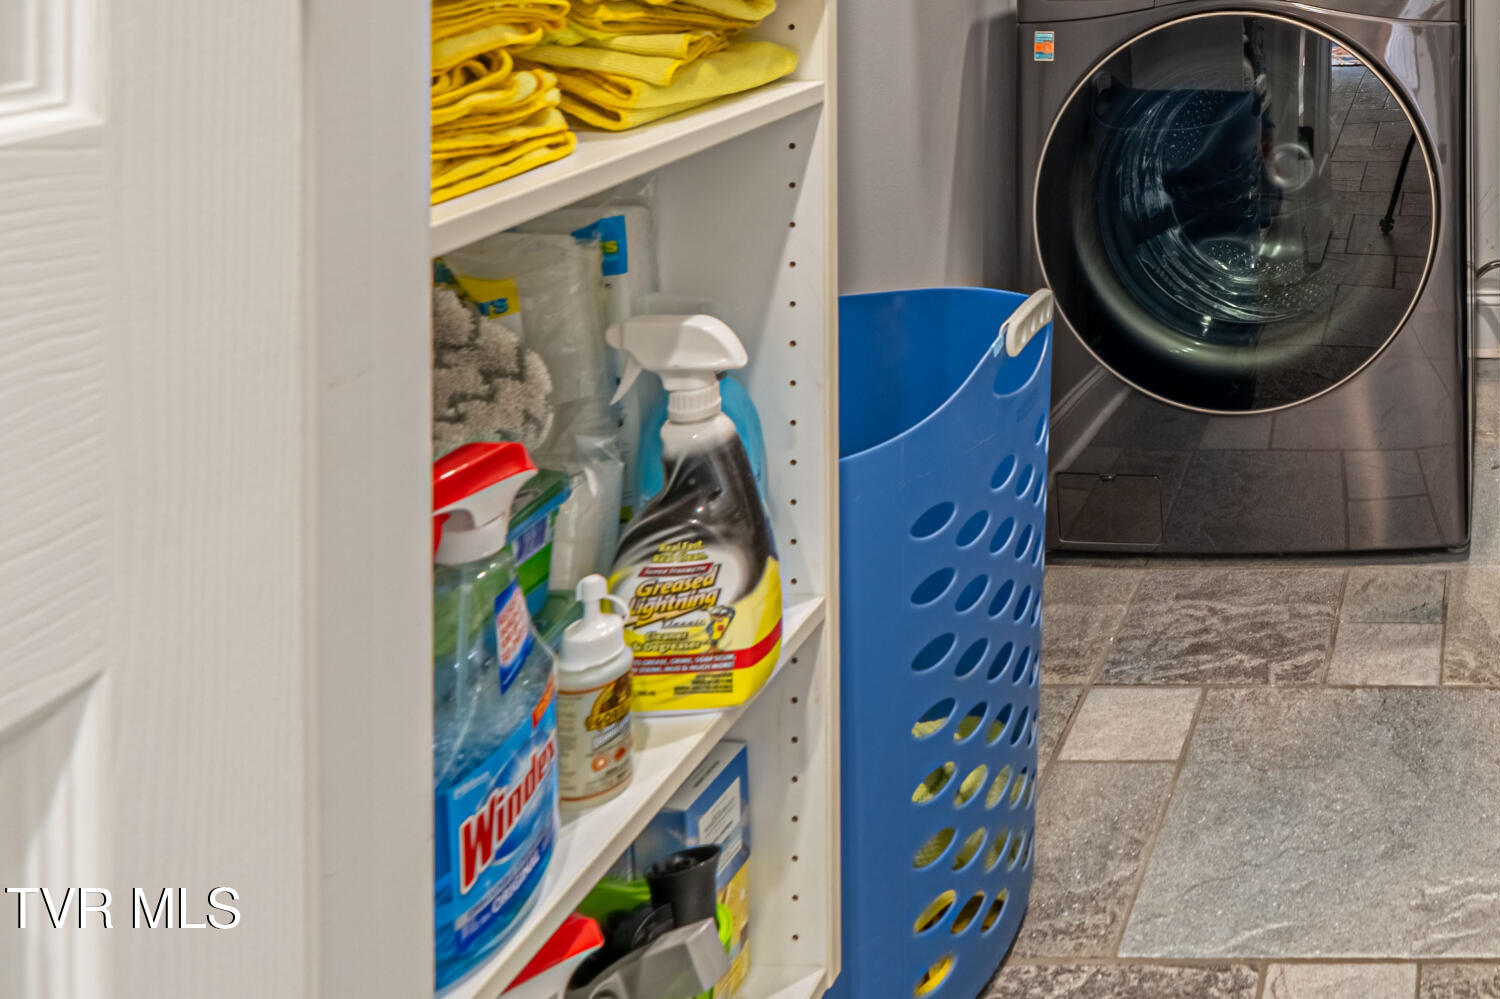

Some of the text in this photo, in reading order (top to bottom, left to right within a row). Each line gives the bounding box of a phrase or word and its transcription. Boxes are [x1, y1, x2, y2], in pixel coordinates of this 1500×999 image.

[635, 564, 721, 597] Greased
[629, 588, 722, 620] Lightning
[460, 732, 557, 894] Windex
